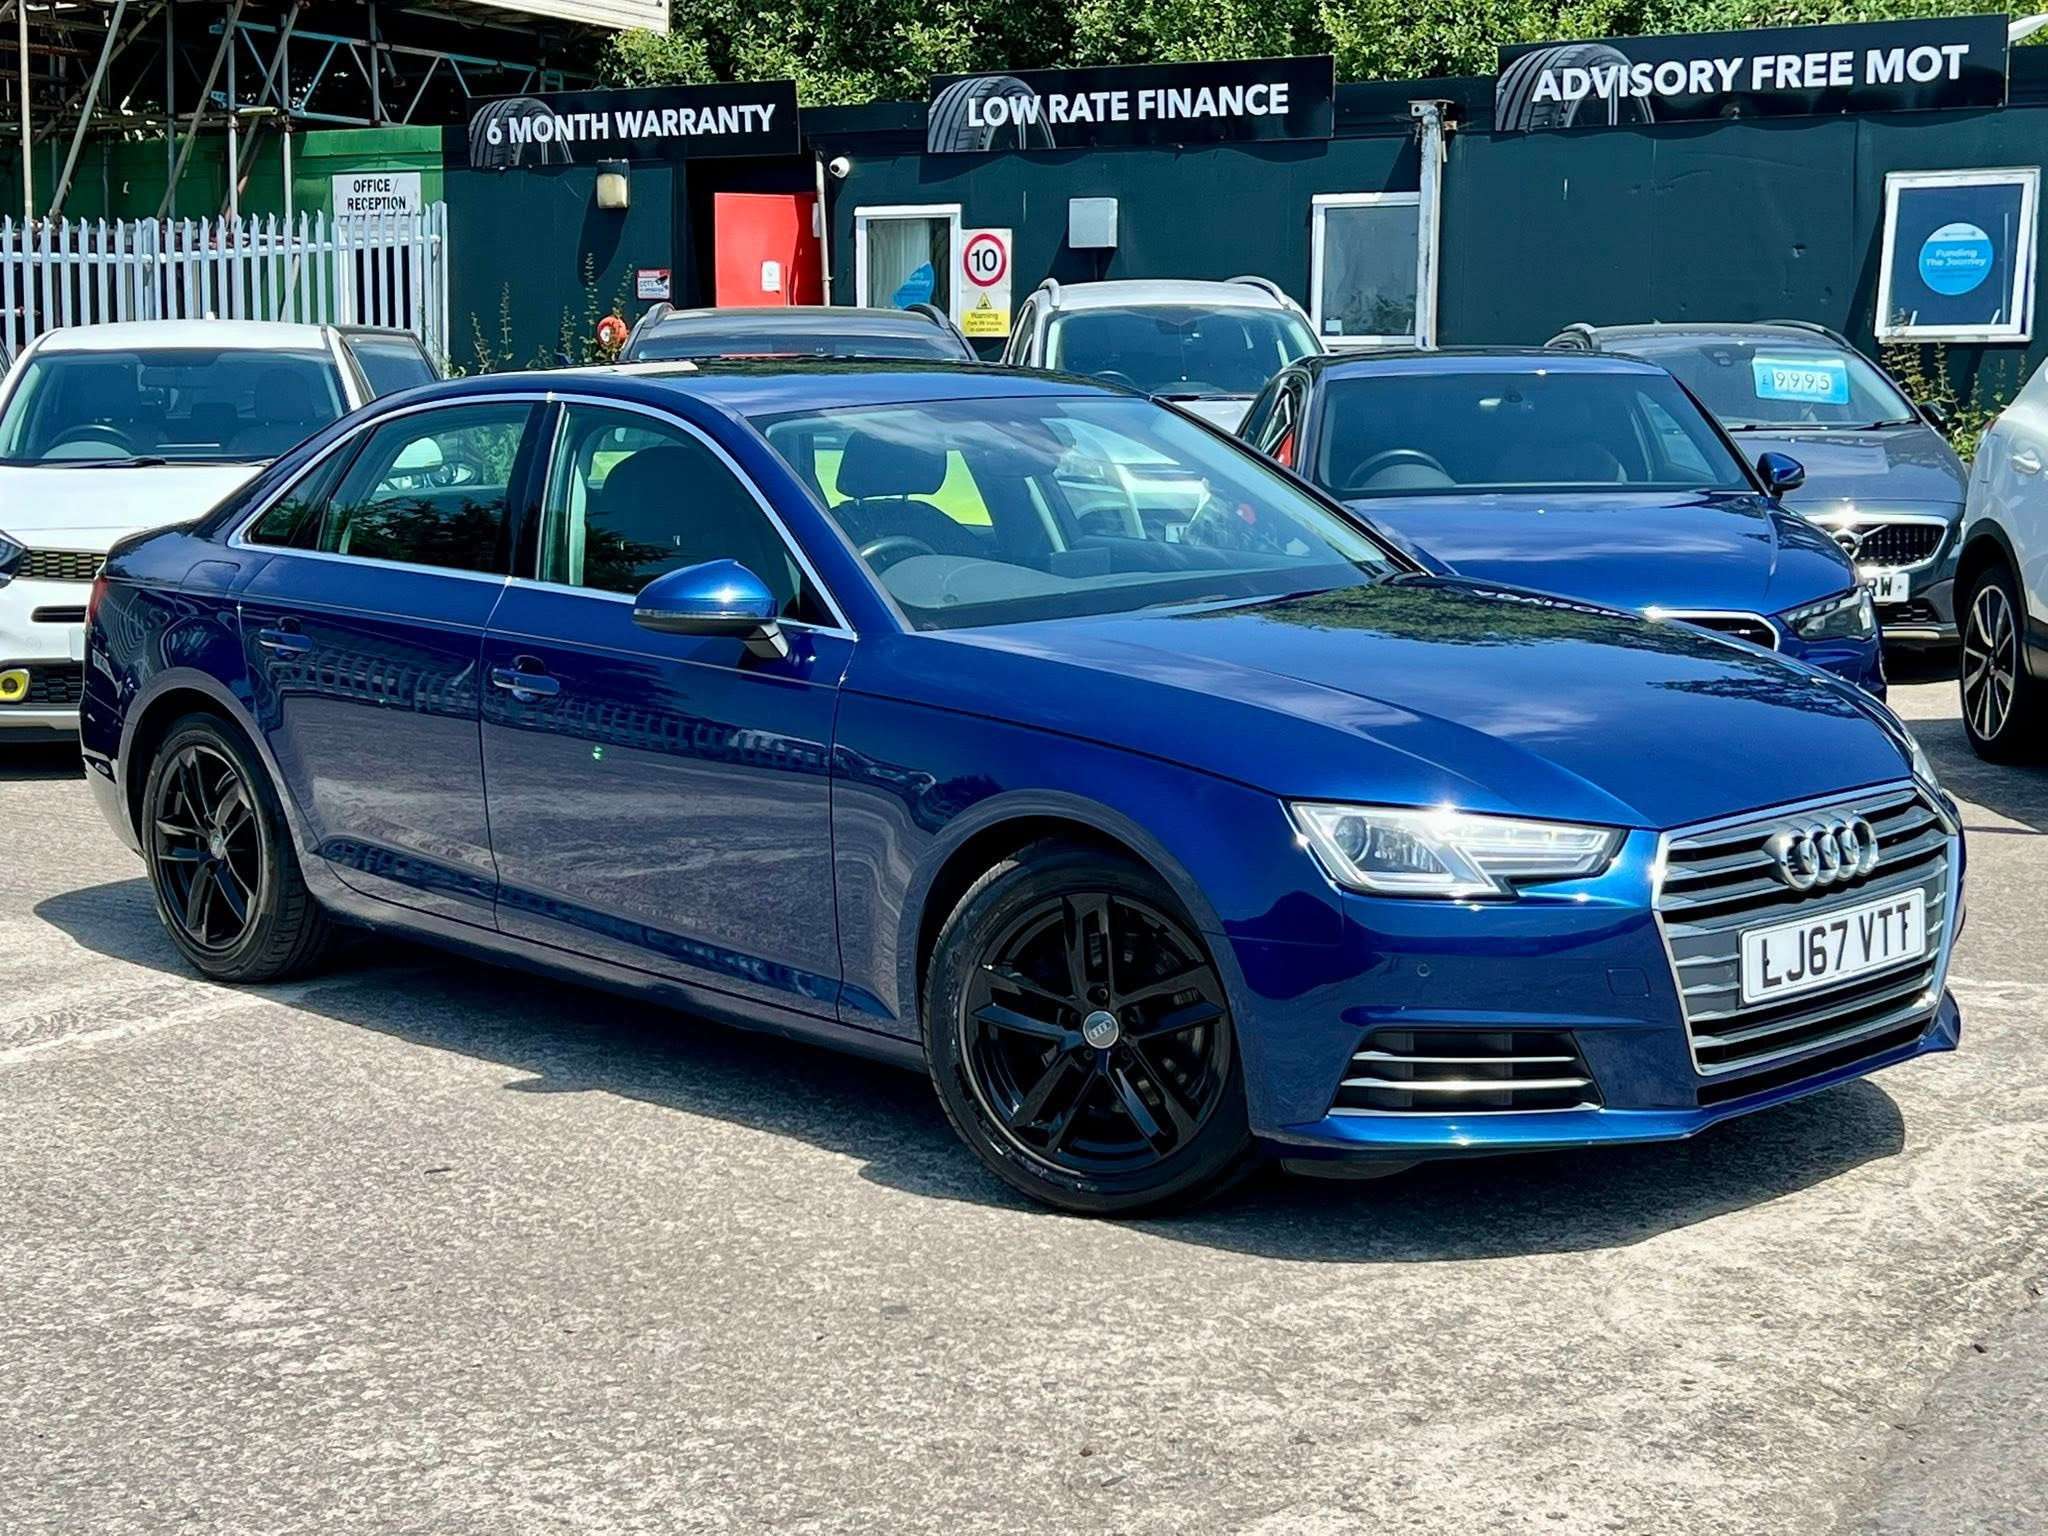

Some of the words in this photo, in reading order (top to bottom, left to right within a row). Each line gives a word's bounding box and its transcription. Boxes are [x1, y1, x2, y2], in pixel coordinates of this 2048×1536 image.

[1531, 57, 1744, 102] ADVISORY
[1752, 51, 1854, 90] FREE
[1866, 44, 1969, 84] MOT
[486, 118, 502, 145] 6
[509, 112, 609, 144] MONTH
[615, 103, 775, 139] WARRANTY
[968, 94, 1041, 127] LOW
[1049, 90, 1129, 122] RATE
[1138, 83, 1289, 119] FINANCE
[347, 196, 407, 211] RECEPTION
[353, 178, 391, 193] OFFICE
[971, 248, 997, 272] 10
[1761, 919, 1848, 988] LJ67
[1859, 902, 1910, 962] VTT
